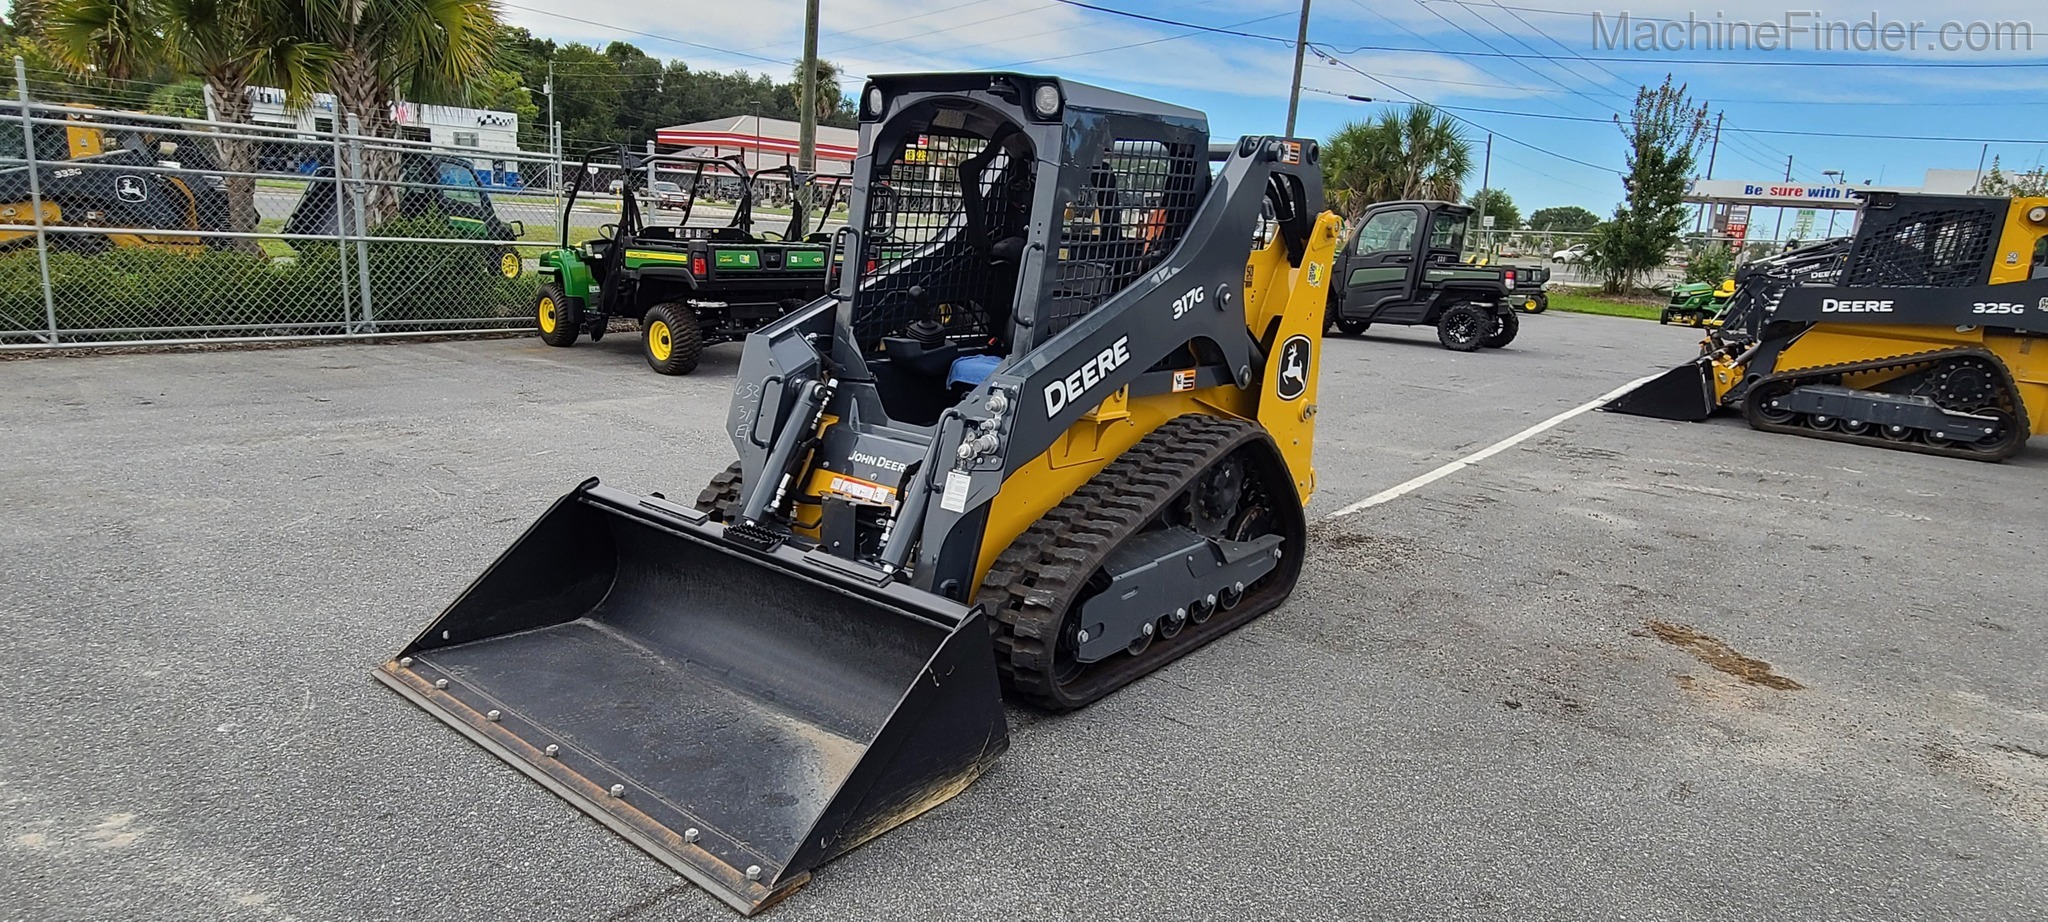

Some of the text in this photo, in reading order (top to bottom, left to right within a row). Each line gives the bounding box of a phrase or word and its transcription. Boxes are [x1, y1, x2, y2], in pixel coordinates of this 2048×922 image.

[1744, 184, 1763, 195] Be
[1770, 186, 1803, 197] sure
[1807, 187, 1840, 199] with
[1173, 286, 1204, 320] 317G
[1822, 299, 1894, 312] DEERE
[1972, 303, 2024, 314] 325G
[1044, 336, 1130, 418] DEERE
[848, 451, 908, 473] JOHN DEER
